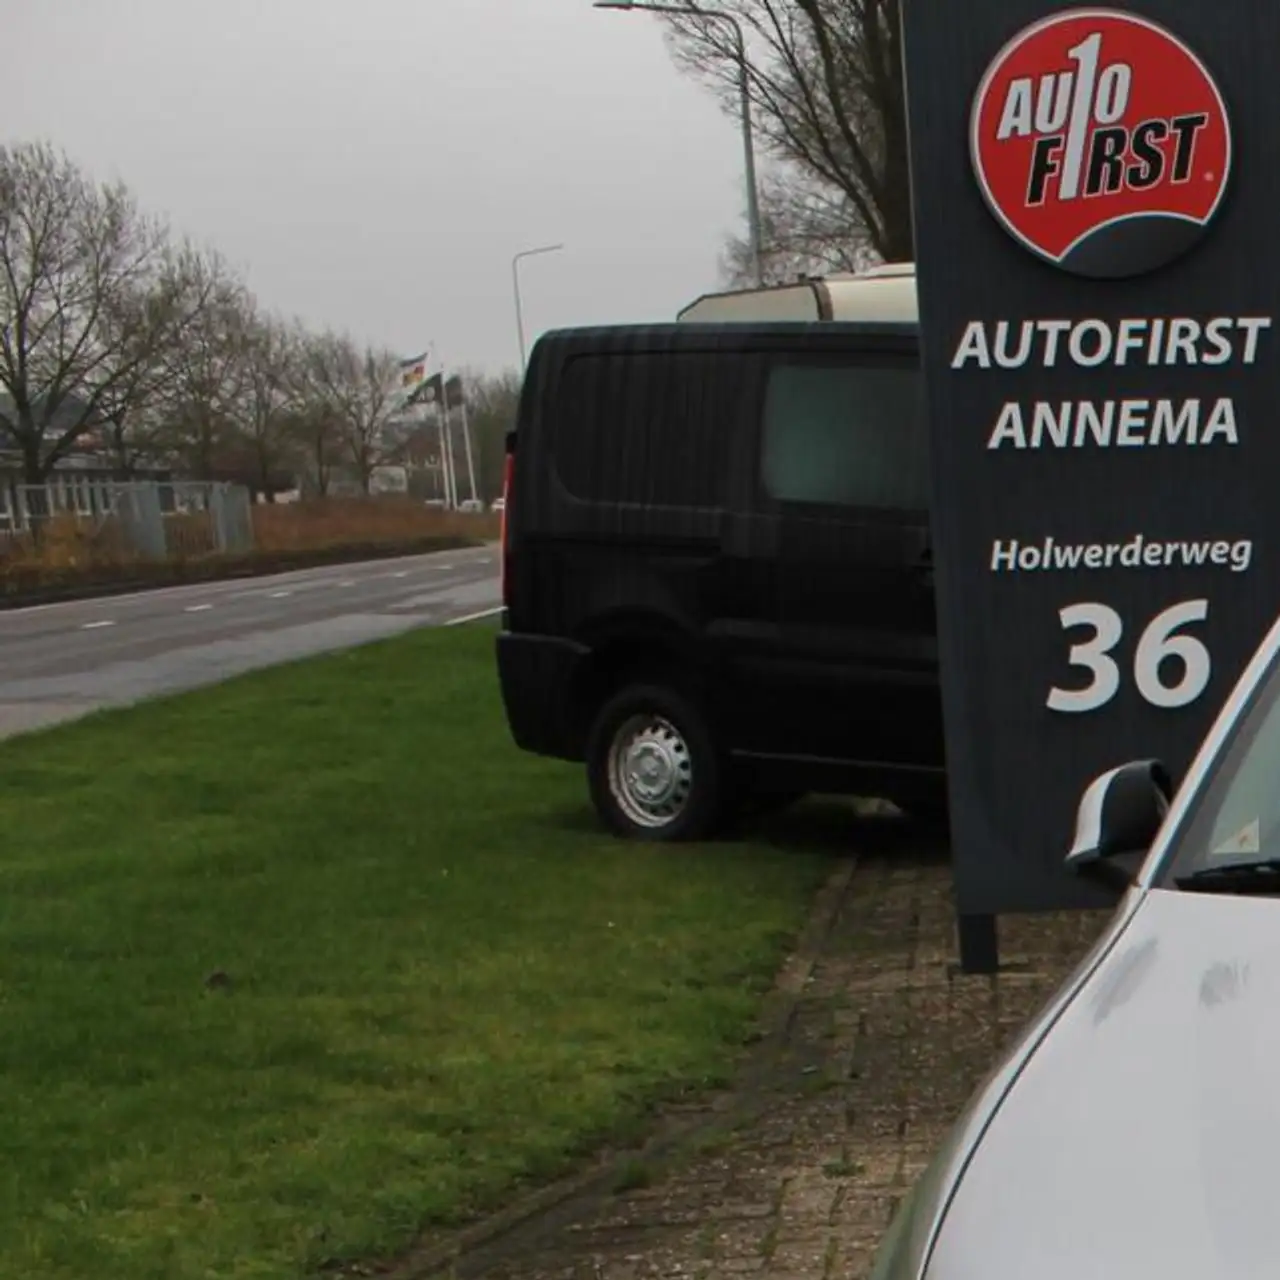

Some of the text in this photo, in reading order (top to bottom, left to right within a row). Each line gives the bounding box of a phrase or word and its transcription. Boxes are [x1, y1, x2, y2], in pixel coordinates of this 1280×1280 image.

[951, 316, 1271, 369] AUTOFIRST
[988, 398, 1239, 450] ANNEMA
[990, 534, 1252, 572] Holwerderweg
[1045, 599, 1211, 713] 36
